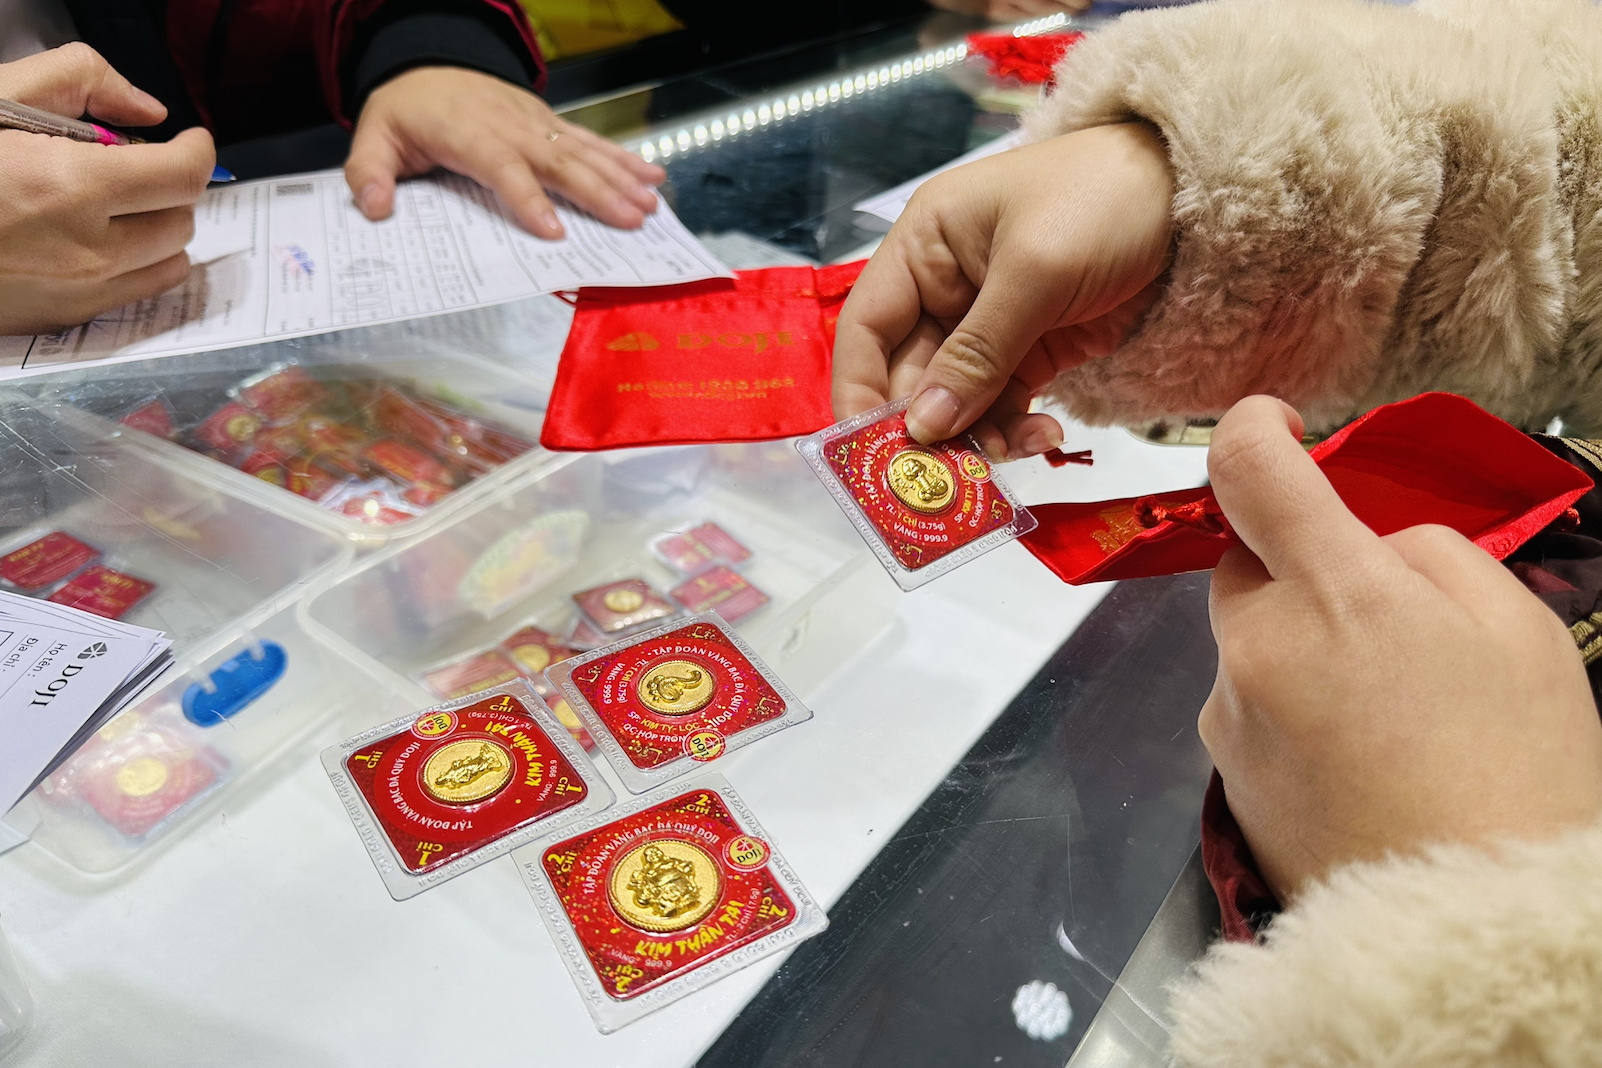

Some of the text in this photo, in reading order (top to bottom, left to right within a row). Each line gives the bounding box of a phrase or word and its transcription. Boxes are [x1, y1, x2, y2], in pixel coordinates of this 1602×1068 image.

[677, 330, 799, 354] DOJI
[961, 500, 975, 515] KIM
[917, 520, 947, 532] (3.75g)
[923, 534, 949, 543] 999.9
[3, 637, 39, 668] Địa chỉ
[48, 643, 68, 656] Họ
[652, 645, 673, 656] TẬP
[675, 643, 707, 656] ĐOÀN
[32, 657, 53, 672] tên
[707, 650, 733, 670] VÀNG
[606, 661, 626, 682] VÀNG
[729, 666, 744, 684] BẠC
[27, 664, 84, 708] DOJI
[602, 684, 613, 705] 999.9
[617, 681, 629, 704] (3.75g)
[489, 704, 514, 713] CHỈ
[499, 696, 511, 706] 1
[729, 694, 744, 713] QUÝ
[467, 711, 499, 721] (3.75g)
[627, 710, 642, 723] SP:
[641, 718, 659, 730] KIM
[709, 711, 734, 728] DOJI
[509, 731, 543, 761] THẦN
[354, 754, 371, 762] 1
[367, 750, 384, 769] CHỈ
[523, 761, 545, 787] KIM
[548, 759, 558, 778] 999.9
[387, 740, 474, 832] TẬP ĐOÀN VÀNG BẠC ĐÁ QUÝ DOJI
[554, 776, 569, 797] CHỈ
[566, 783, 583, 793] 1
[695, 794, 709, 806] 2
[605, 830, 635, 852] VÀNG
[697, 827, 720, 844] DOJI
[415, 841, 444, 853] CHỈ
[418, 850, 432, 867] 1
[547, 853, 566, 865] 2
[560, 850, 579, 873] CHỈ
[590, 848, 612, 877] ĐOÀN
[582, 875, 600, 895] TẬP
[757, 896, 773, 920] CHỈ
[769, 903, 788, 918] 2
[634, 899, 746, 960] KIM THẦN TÀI
[644, 958, 674, 969] 999.9
